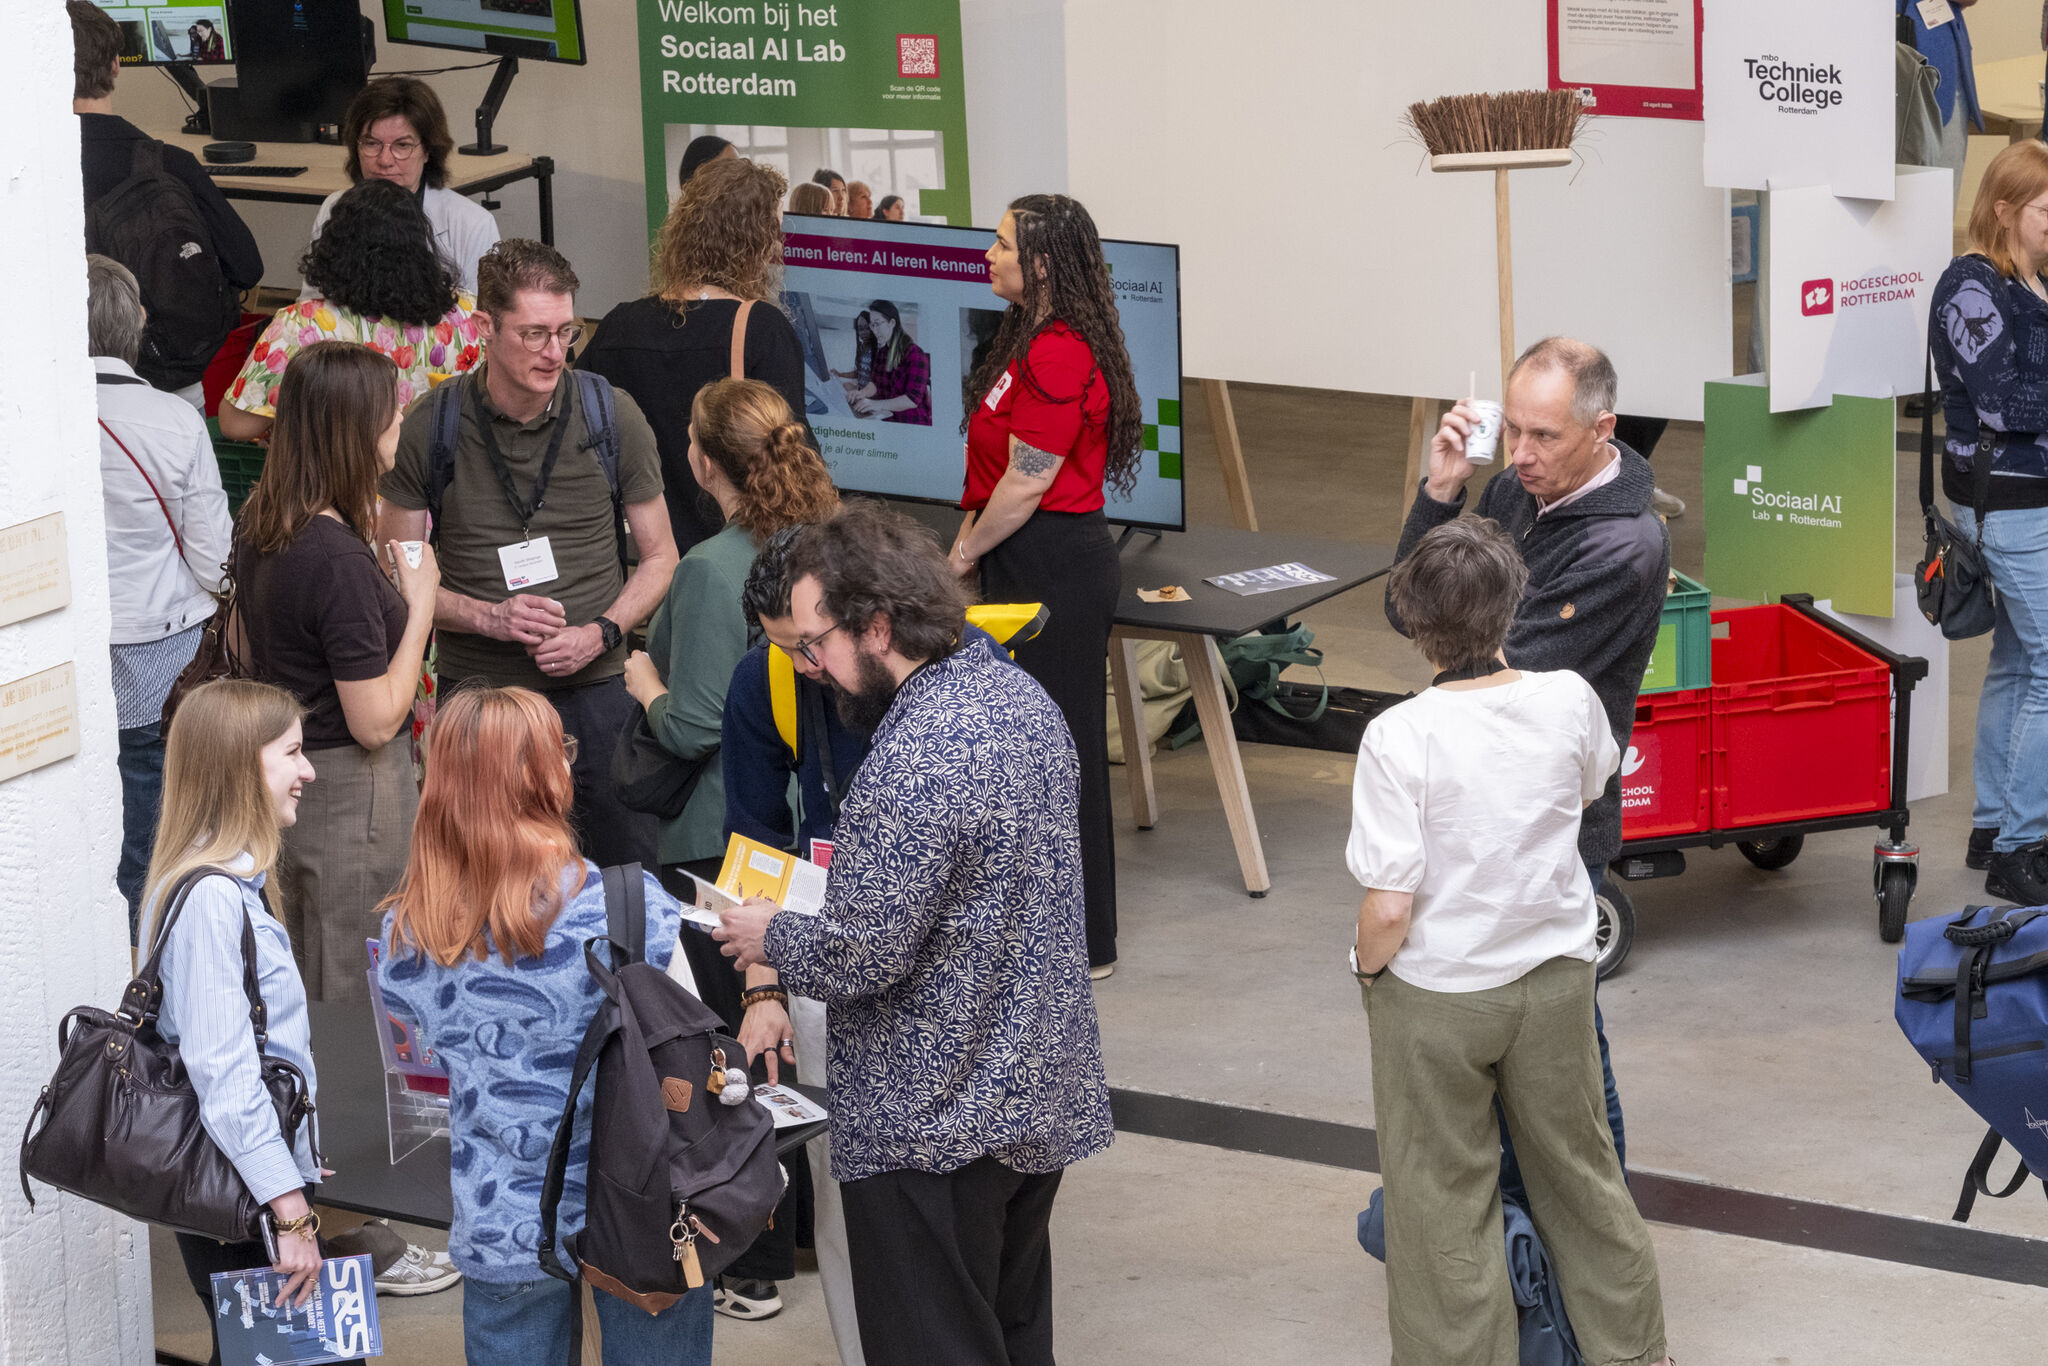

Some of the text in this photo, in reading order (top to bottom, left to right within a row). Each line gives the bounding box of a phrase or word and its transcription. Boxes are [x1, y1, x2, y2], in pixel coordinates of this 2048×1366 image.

[658, 0, 838, 32] Welkom bij het
[660, 34, 846, 62] Sociaal AI Lab
[663, 70, 797, 96] Rotterdam
[1744, 59, 1842, 84] Techniek
[1759, 80, 1843, 109] College
[1778, 105, 1818, 115] Rotterdam
[784, 246, 986, 275] amen leren: AI leren kennen
[1109, 278, 1163, 294] Sociaal AI
[1840, 271, 1925, 292] HOGESCHOOL
[1840, 288, 1916, 307] ROTTERDAM
[1751, 487, 1843, 514] Sociaal AI
[1752, 510, 1842, 528] Lab Rotterdam
[1621, 786, 1655, 797] CHOOL
